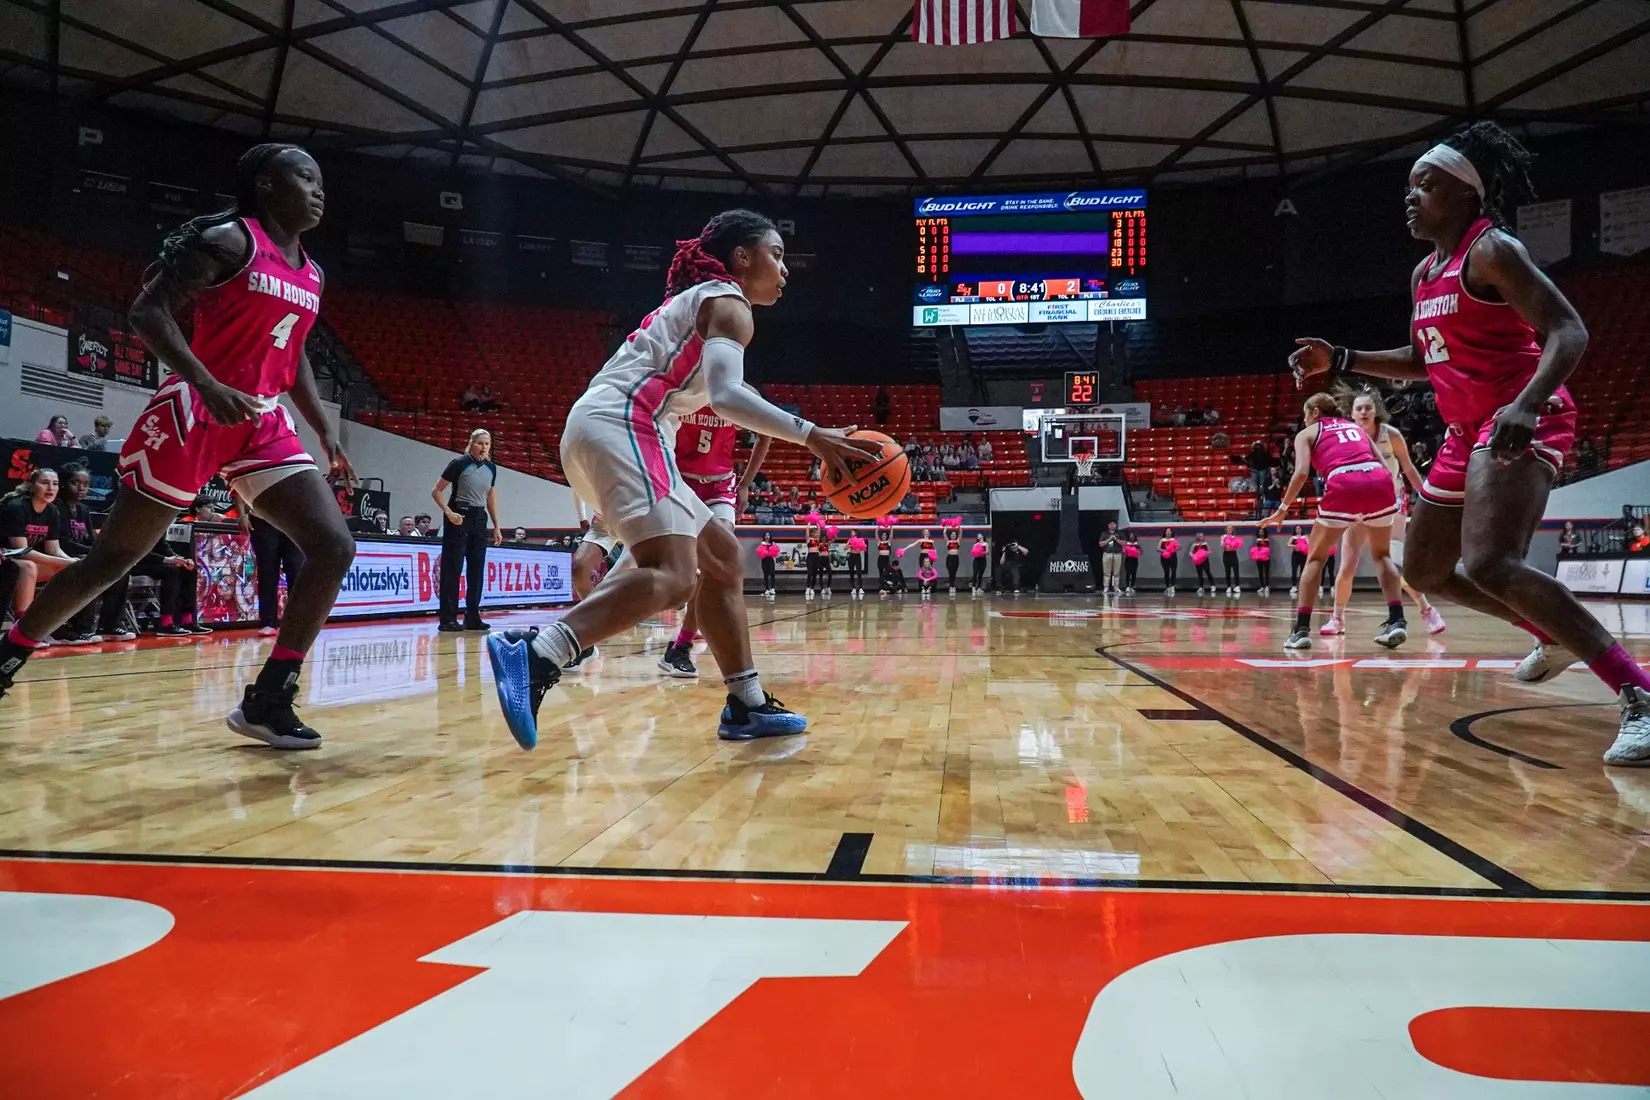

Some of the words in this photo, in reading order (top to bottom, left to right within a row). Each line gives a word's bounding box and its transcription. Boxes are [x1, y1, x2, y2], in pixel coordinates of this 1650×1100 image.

[78, 126, 104, 146] P
[1070, 197, 1100, 206] BUD
[1100, 196, 1143, 204] LIGHT
[926, 203, 956, 212] BUD
[955, 202, 996, 210] LIGHT
[1273, 199, 1300, 217] A
[1116, 219, 1122, 227] 3
[1128, 219, 1134, 227] 0
[1140, 218, 1146, 227] 0
[920, 227, 925, 235] 0
[943, 226, 949, 234] 0
[1114, 229, 1122, 237] 15
[1128, 229, 1134, 237] 0
[1140, 228, 1146, 236] 2
[943, 236, 949, 244] 0
[1114, 239, 1122, 247] 18
[1128, 238, 1134, 246] 0
[1140, 238, 1146, 246] 0
[920, 246, 925, 254] 5
[931, 246, 937, 254] 0
[943, 245, 948, 253] 0
[1111, 248, 1122, 256] 23
[1128, 248, 1134, 256] 0
[1140, 248, 1146, 256] 0
[931, 255, 937, 263] 0
[1111, 258, 1122, 266] 30
[1128, 258, 1134, 266] 0
[917, 265, 925, 273] 10
[931, 265, 937, 273] 0
[942, 264, 948, 272] 0
[248, 271, 281, 298] SAM
[997, 283, 1006, 294] 0
[1019, 282, 1044, 293] 8:41
[1067, 281, 1075, 292] 2
[1420, 293, 1459, 320] HOUSTON
[974, 313, 1025, 323] HERMANN
[270, 312, 300, 350] 4
[1417, 326, 1450, 365] 12
[1074, 375, 1095, 385] 8:41
[1072, 385, 1092, 402] 22
[697, 429, 713, 454] 5
[1336, 429, 1362, 444] 10
[848, 474, 891, 505] NCAA
[1050, 559, 1089, 569] MEMORIAL
[487, 562, 541, 591] PIZZAS
[547, 565, 559, 577] EVERY
[543, 578, 564, 590] WEDNESDAY
